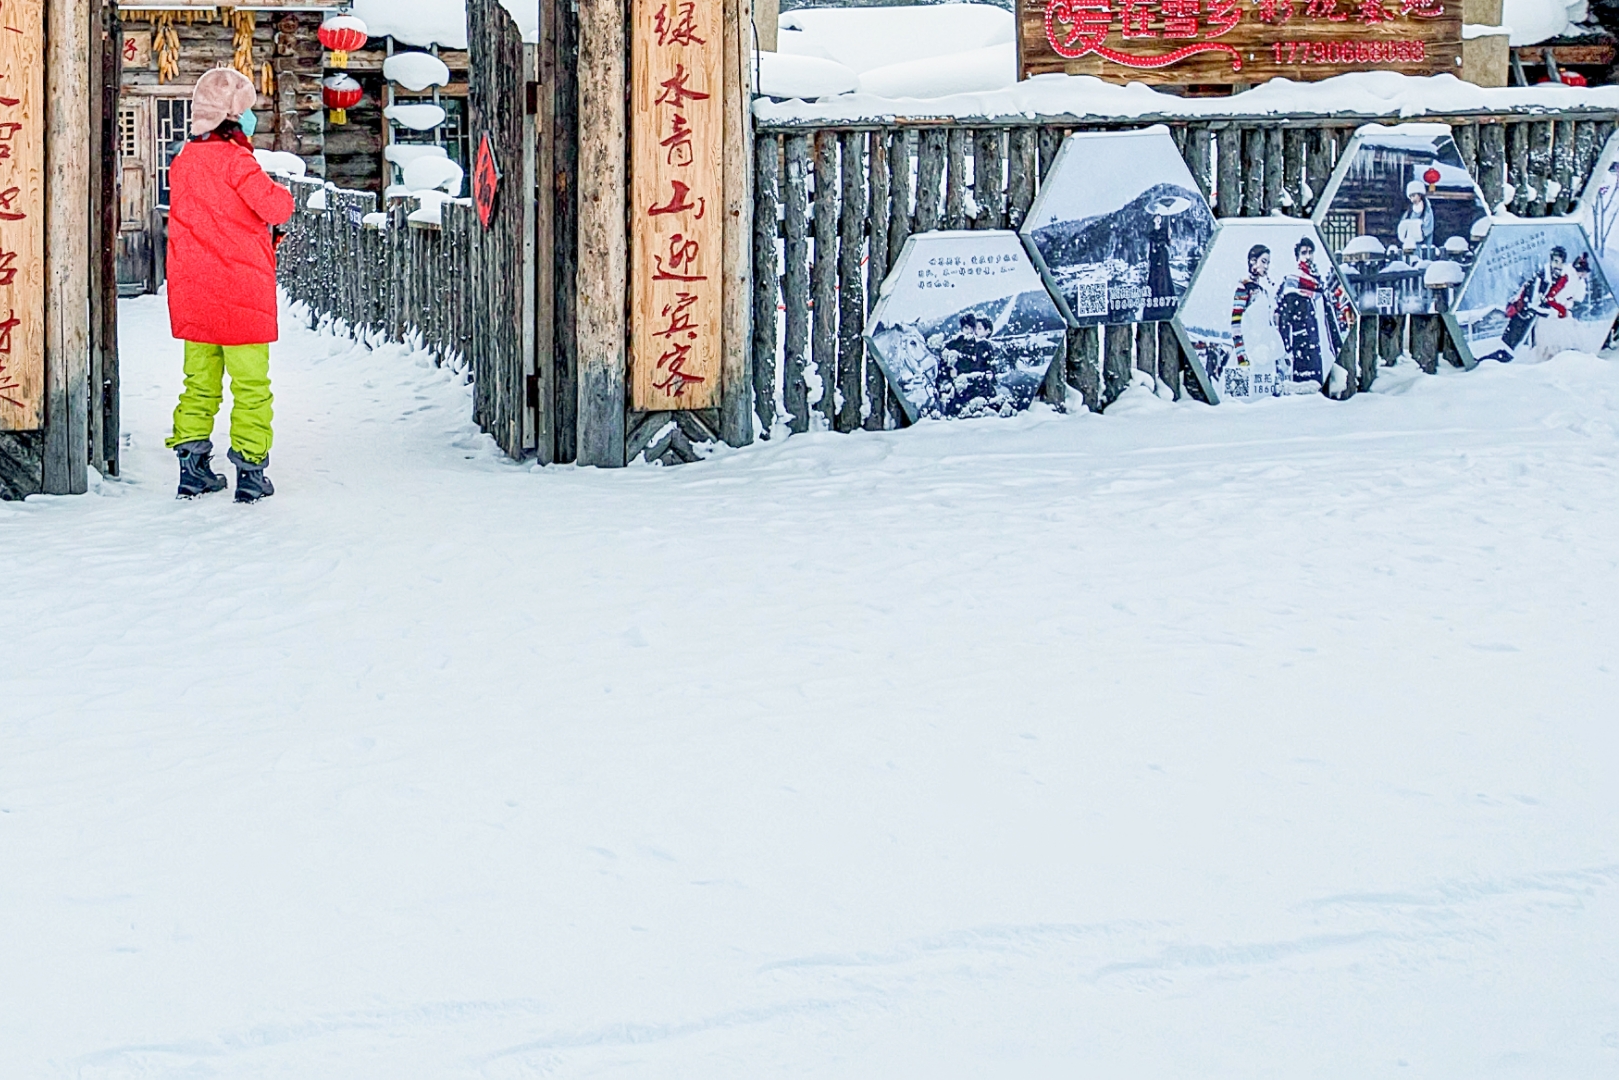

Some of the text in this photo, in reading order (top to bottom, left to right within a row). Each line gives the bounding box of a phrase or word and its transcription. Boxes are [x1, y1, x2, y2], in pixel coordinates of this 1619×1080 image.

[647, 1, 711, 398] 绿水青山迎宾客
